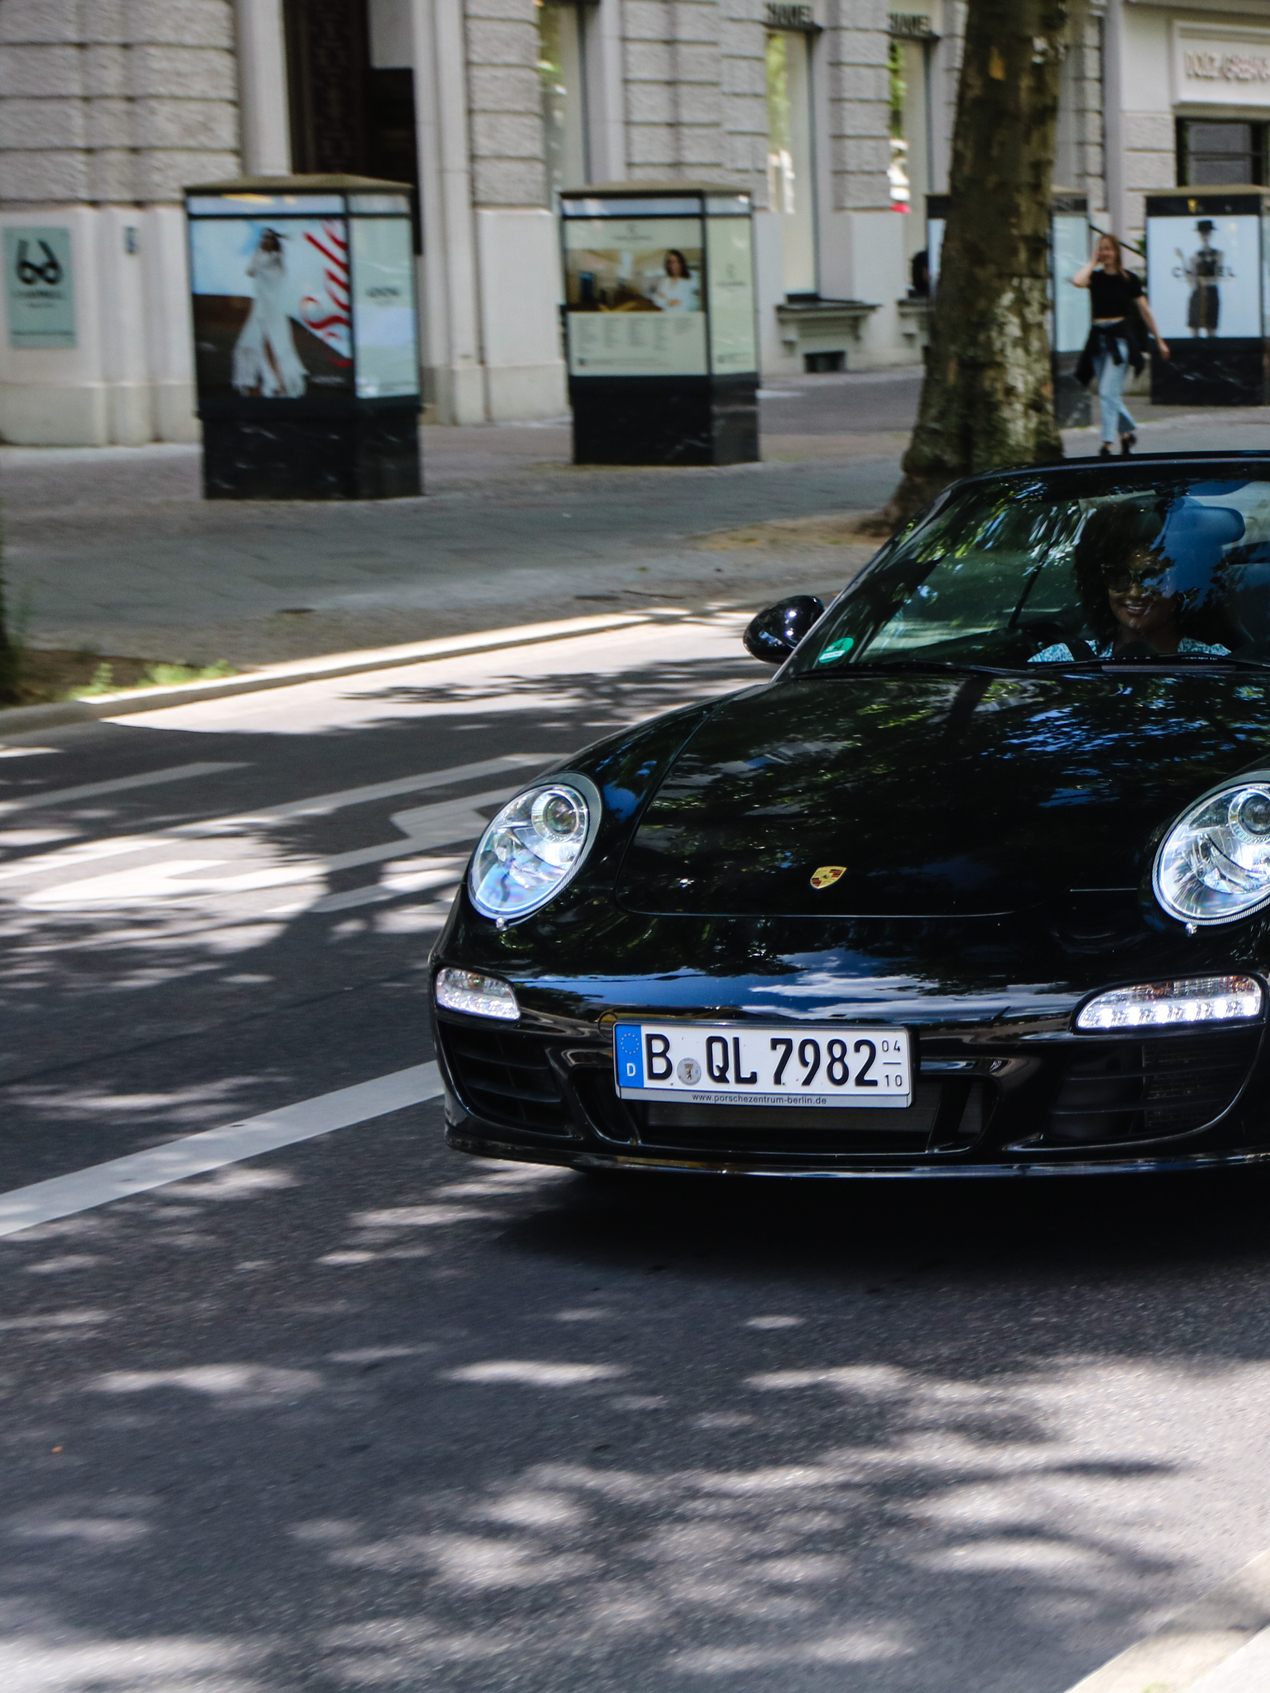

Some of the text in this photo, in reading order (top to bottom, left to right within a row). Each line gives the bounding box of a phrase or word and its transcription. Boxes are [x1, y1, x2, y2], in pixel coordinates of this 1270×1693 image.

[882, 1040, 901, 1052] 04
[645, 1034, 878, 1087] B QL 7982
[626, 1063, 636, 1077] D
[884, 1074, 903, 1088] 10
[692, 1093, 827, 1105] www.porschezentrum-berlin.de
